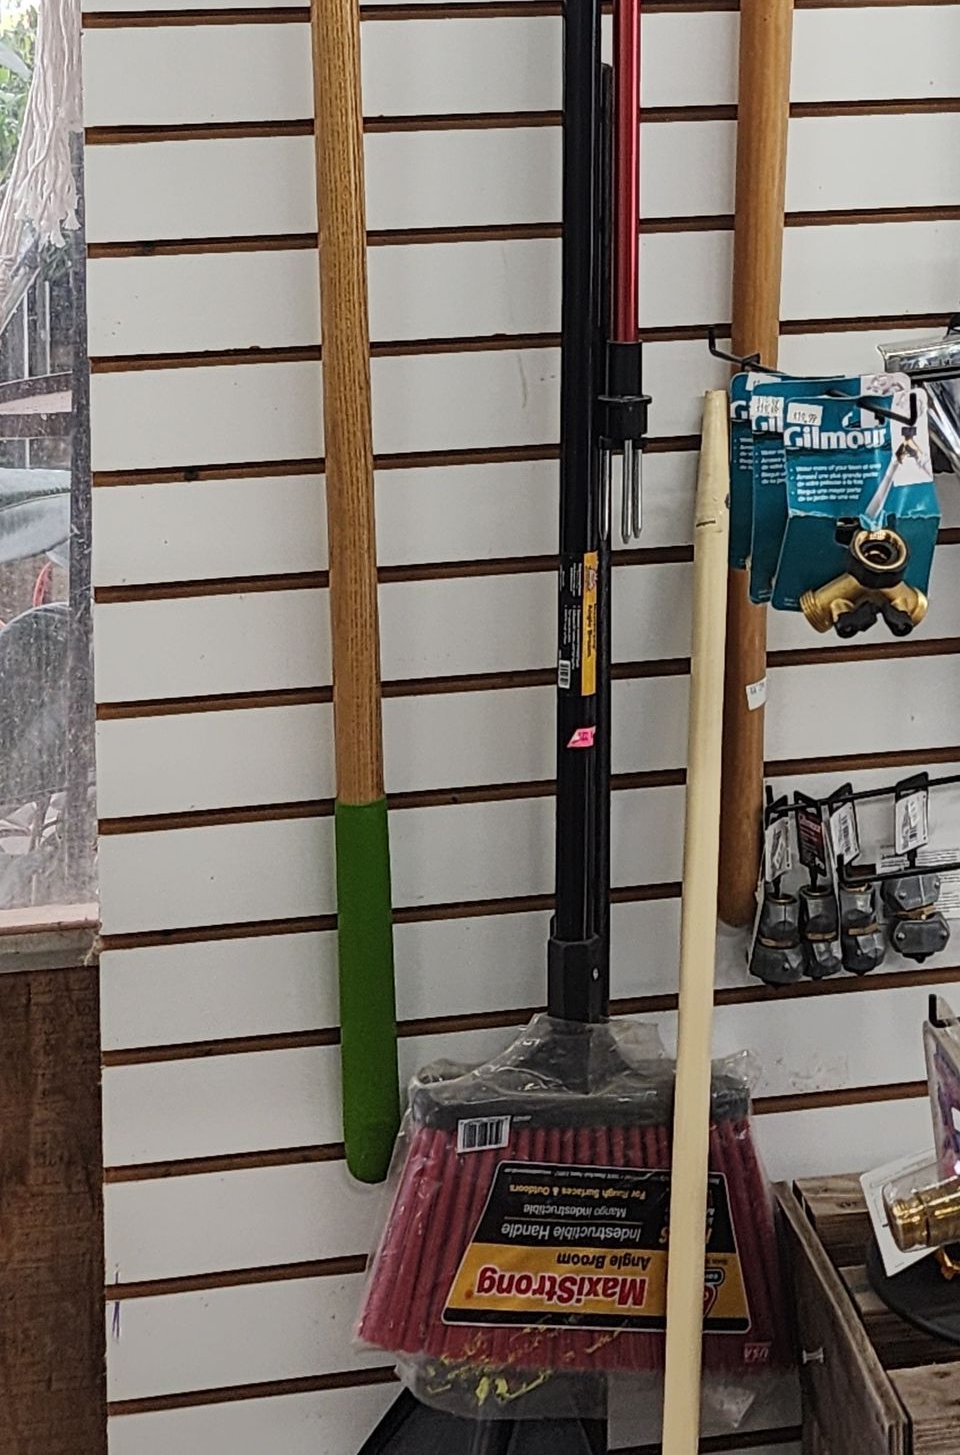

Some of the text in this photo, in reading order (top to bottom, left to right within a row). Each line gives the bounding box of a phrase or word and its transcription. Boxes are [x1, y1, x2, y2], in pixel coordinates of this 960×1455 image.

[784, 425, 886, 450] Gilmour
[508, 1184, 550, 1196] Outdoors
[553, 1186, 559, 1196] &
[561, 1186, 600, 1199] Surfaces
[630, 1190, 646, 1200] For
[523, 1203, 627, 1218] Mango indestructible
[501, 1222, 641, 1242] Indestructible Handle
[556, 1253, 651, 1271] Angle Broom
[475, 1265, 647, 1308] MaxiStrong
